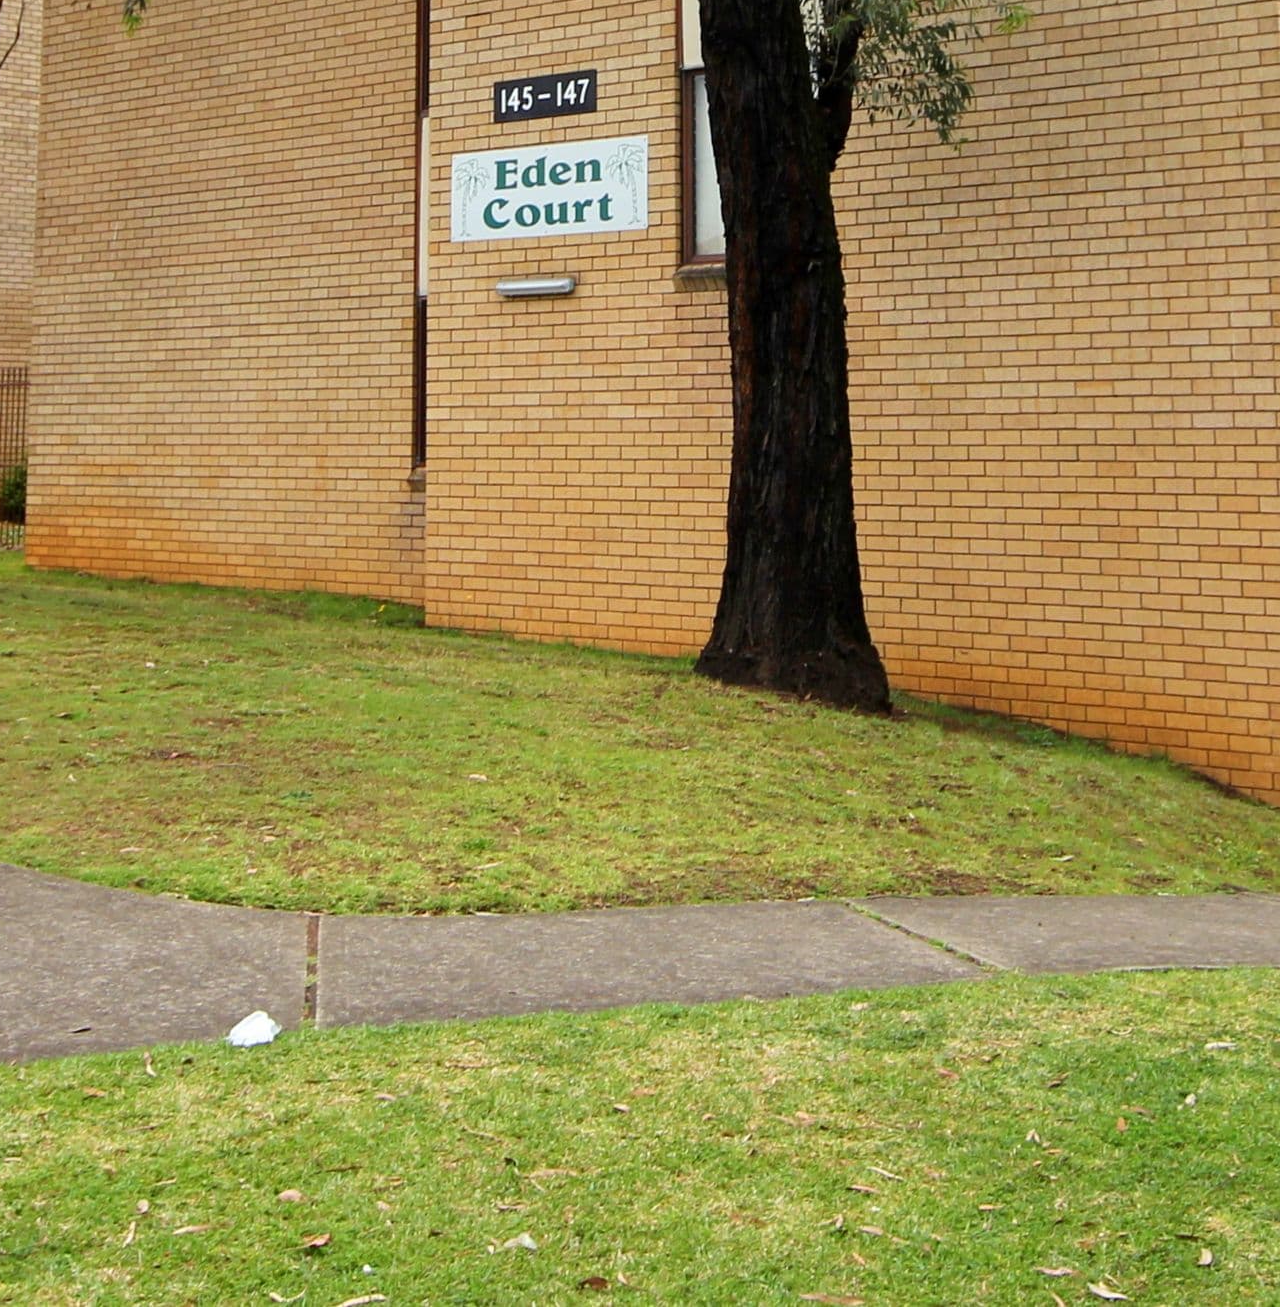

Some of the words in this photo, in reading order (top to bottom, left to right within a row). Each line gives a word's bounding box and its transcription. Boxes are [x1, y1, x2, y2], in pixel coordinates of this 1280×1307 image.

[500, 78, 590, 114] 145-147
[494, 155, 602, 191] Eden
[483, 193, 613, 229] Court
